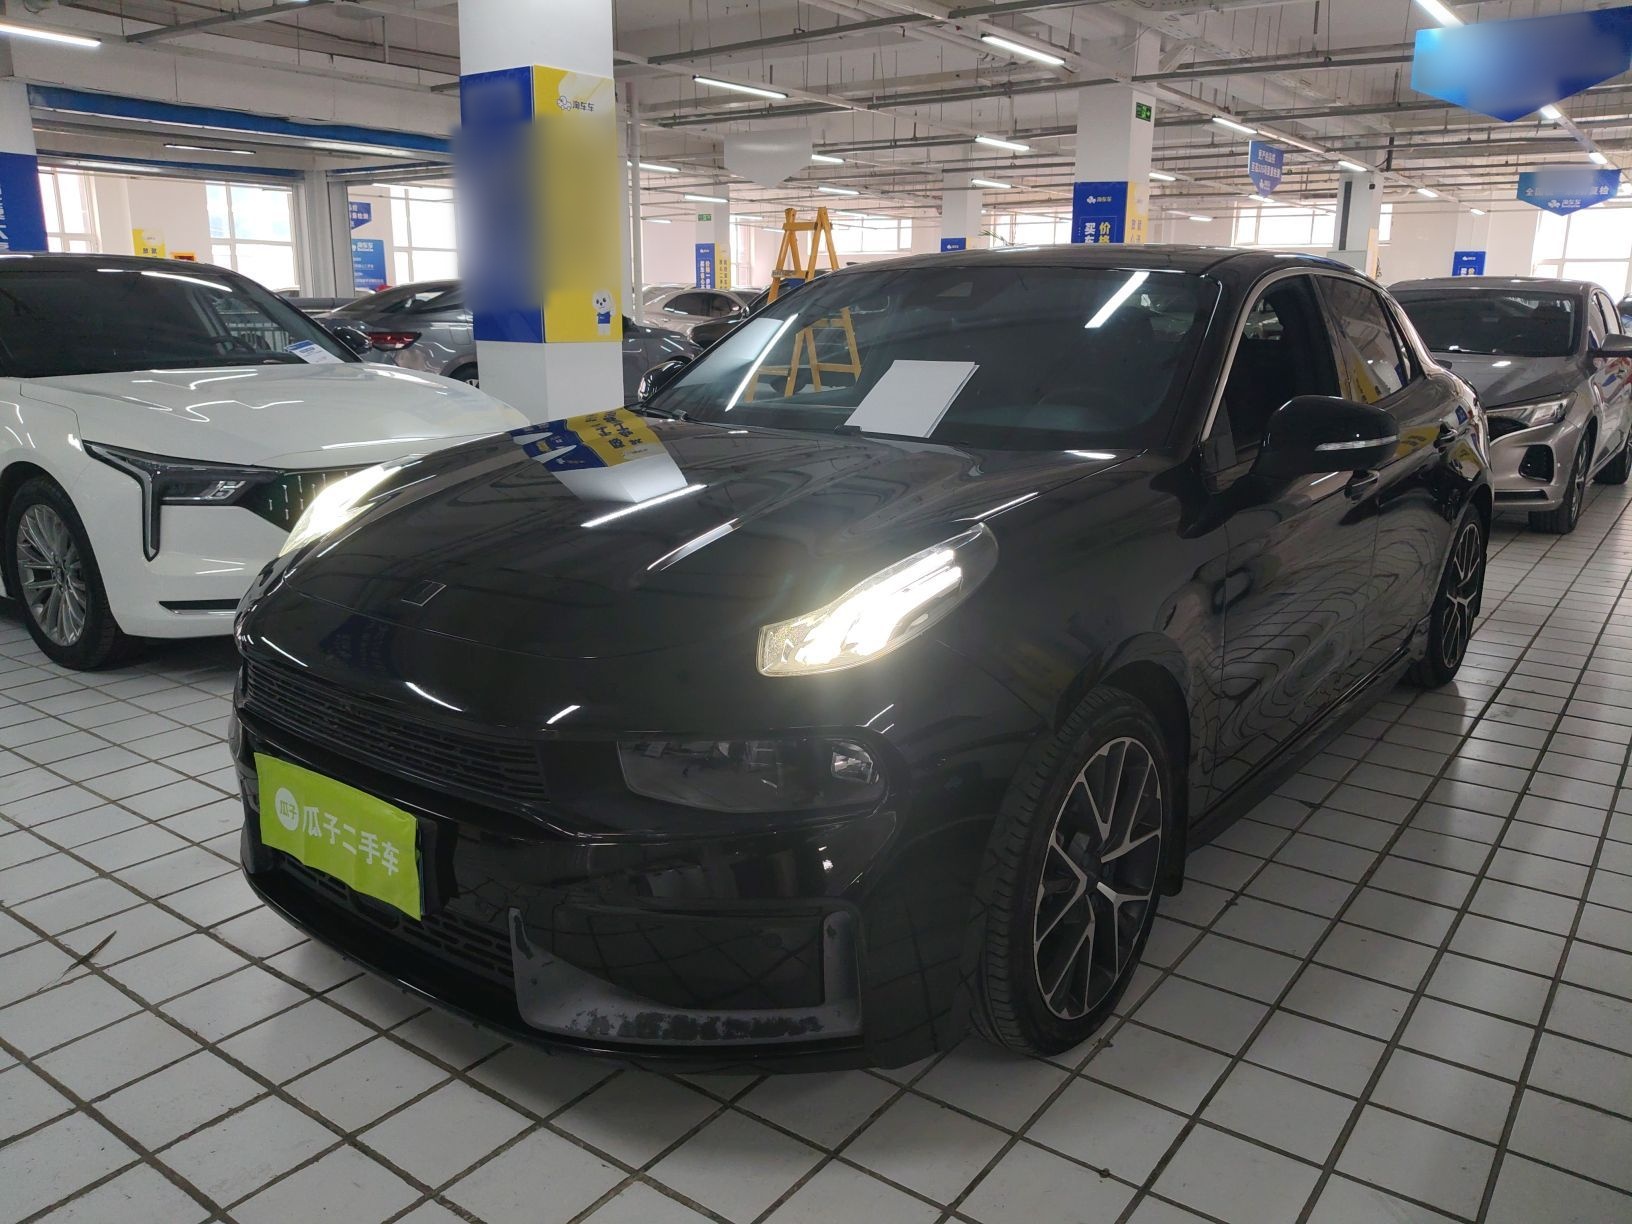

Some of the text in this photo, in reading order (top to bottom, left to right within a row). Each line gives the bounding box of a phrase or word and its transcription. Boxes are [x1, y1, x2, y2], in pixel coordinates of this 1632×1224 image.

[573, 100, 595, 112] 淘车车
[279, 799, 298, 819] 瓜子
[302, 806, 400, 877] 瓜子二手车
